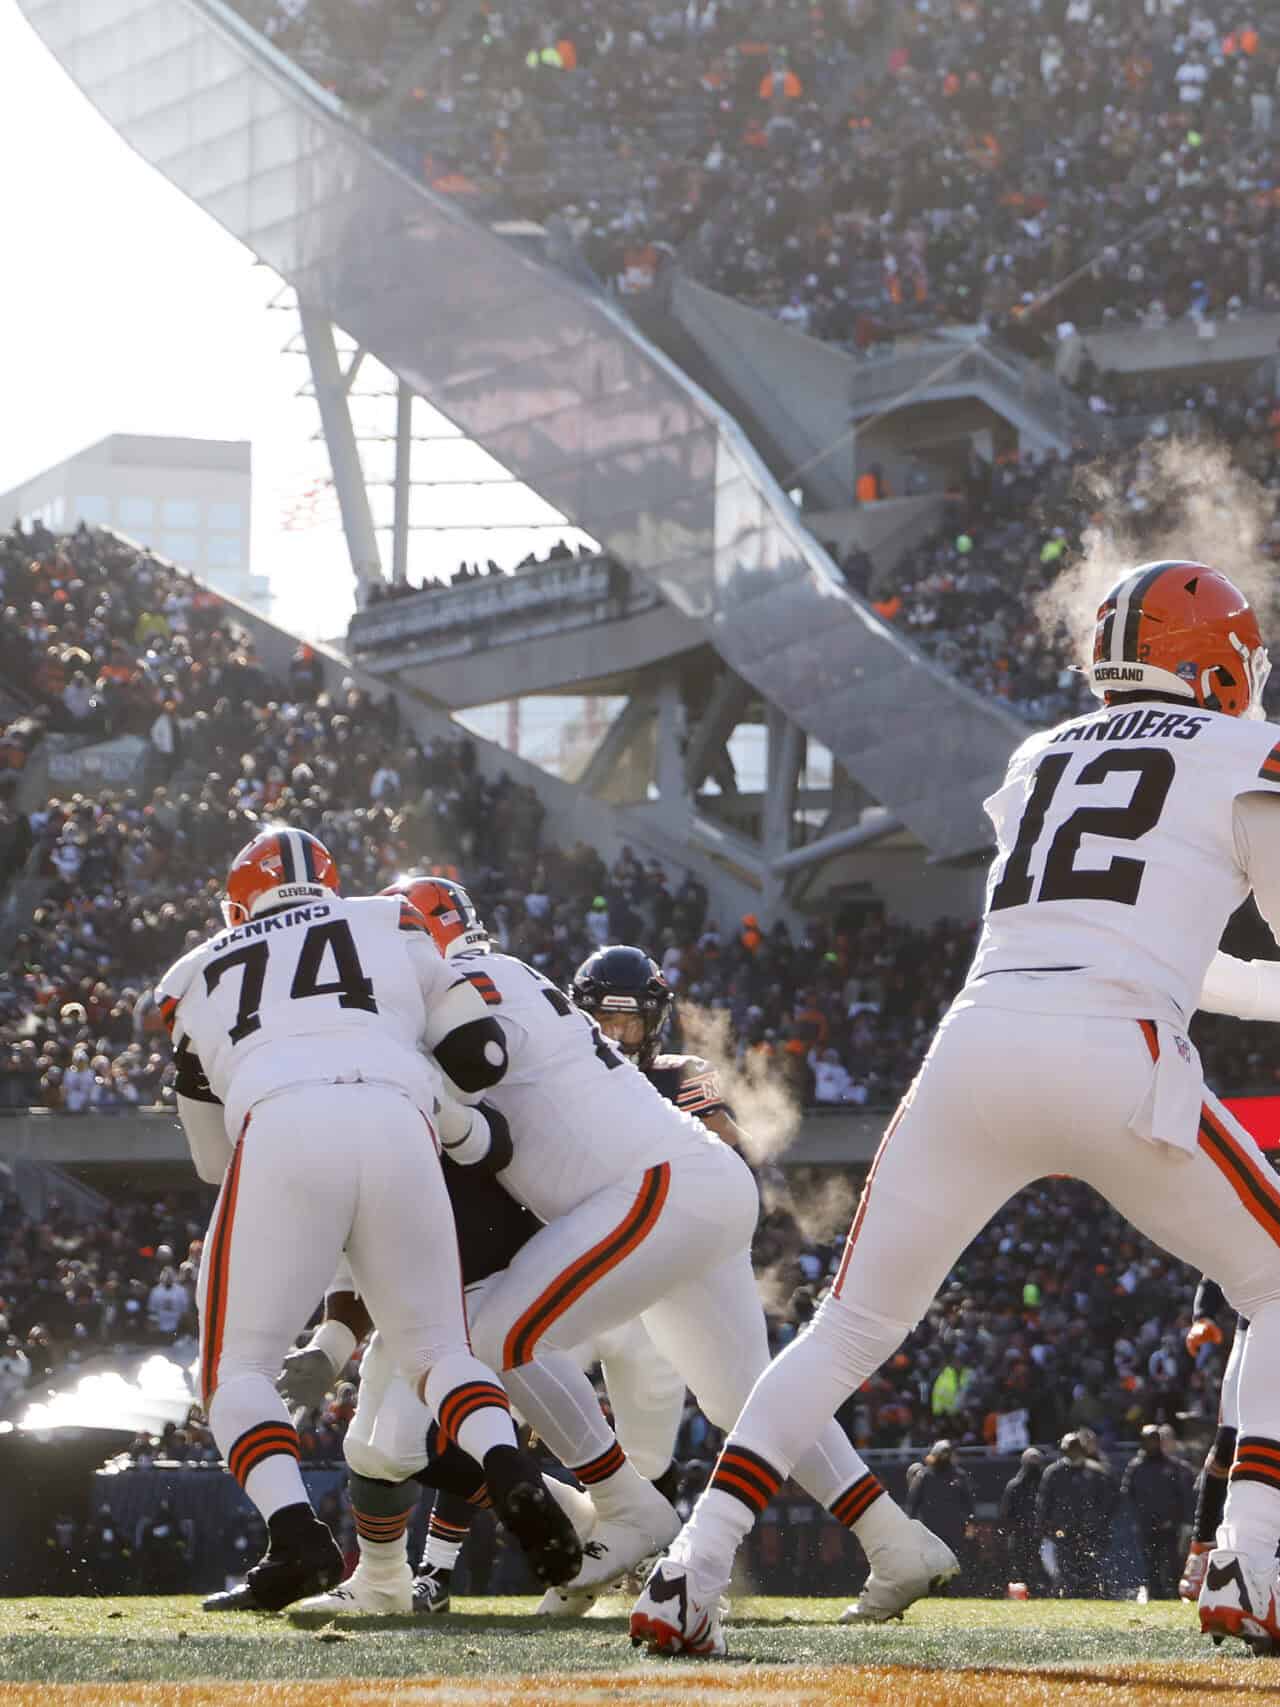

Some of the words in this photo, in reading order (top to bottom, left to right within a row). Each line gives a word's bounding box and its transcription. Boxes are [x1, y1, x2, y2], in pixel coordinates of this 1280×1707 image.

[1094, 667, 1144, 681] CLEVELAND
[989, 747, 1177, 913] 12
[203, 919, 379, 1046] 74
